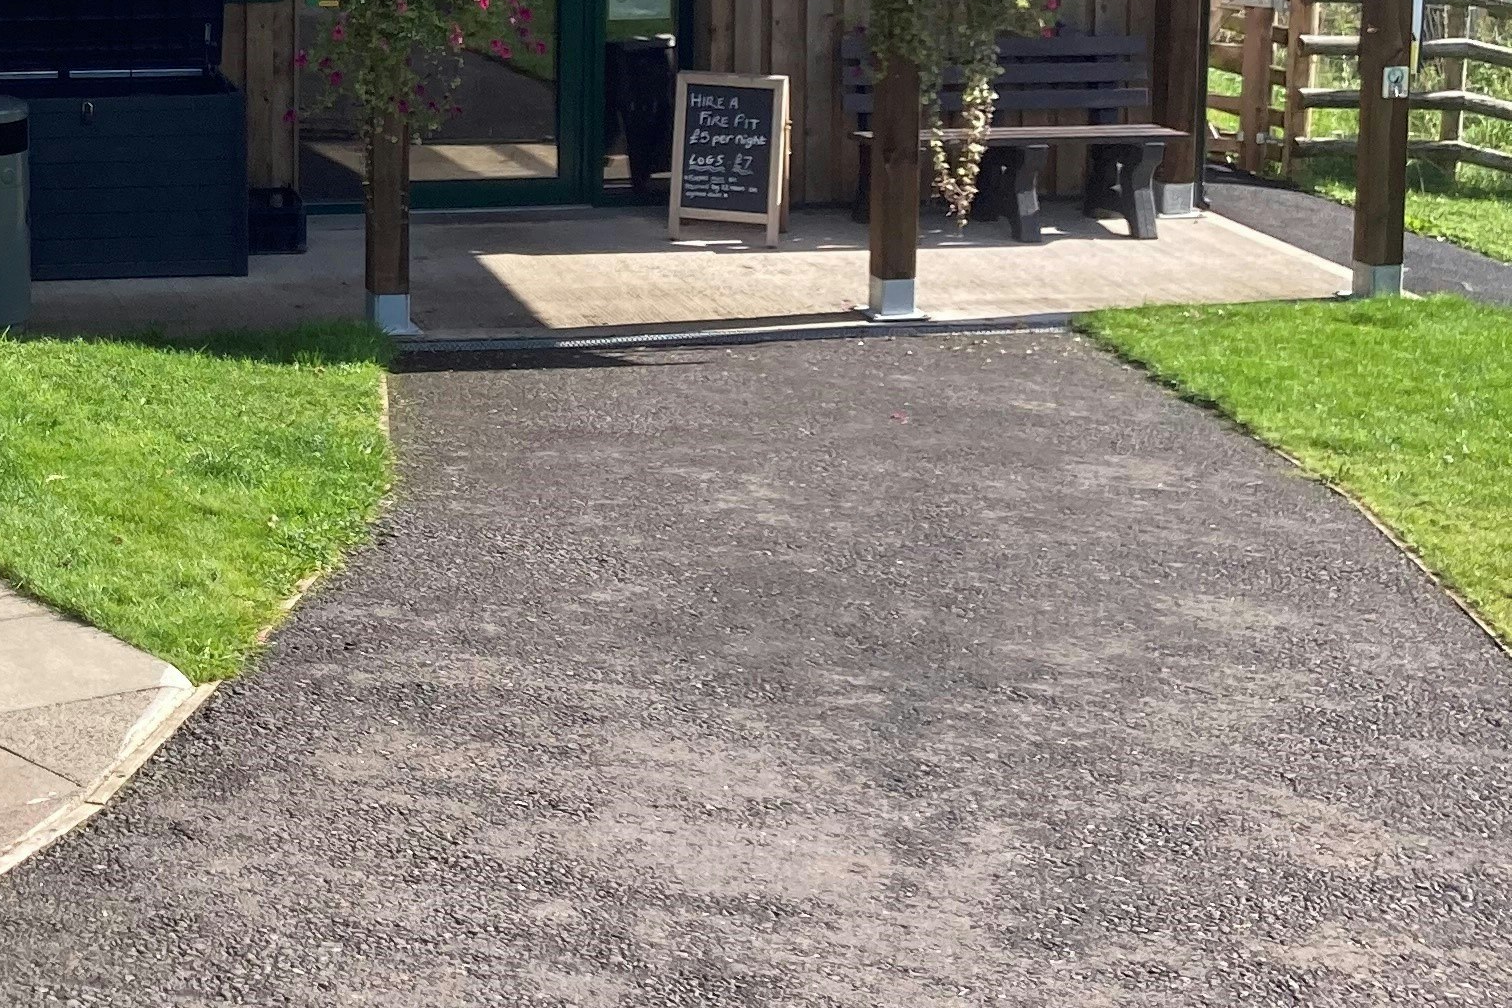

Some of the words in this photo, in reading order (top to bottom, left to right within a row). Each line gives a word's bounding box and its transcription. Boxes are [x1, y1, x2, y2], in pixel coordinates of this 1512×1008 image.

[690, 93, 725, 109] HIRE
[729, 97, 739, 109] A
[699, 111, 728, 128] FIRE
[734, 113, 760, 130] PIT
[689, 128, 710, 144] £5
[711, 134, 734, 147] per
[734, 134, 767, 149] night
[689, 154, 725, 166] LOGS
